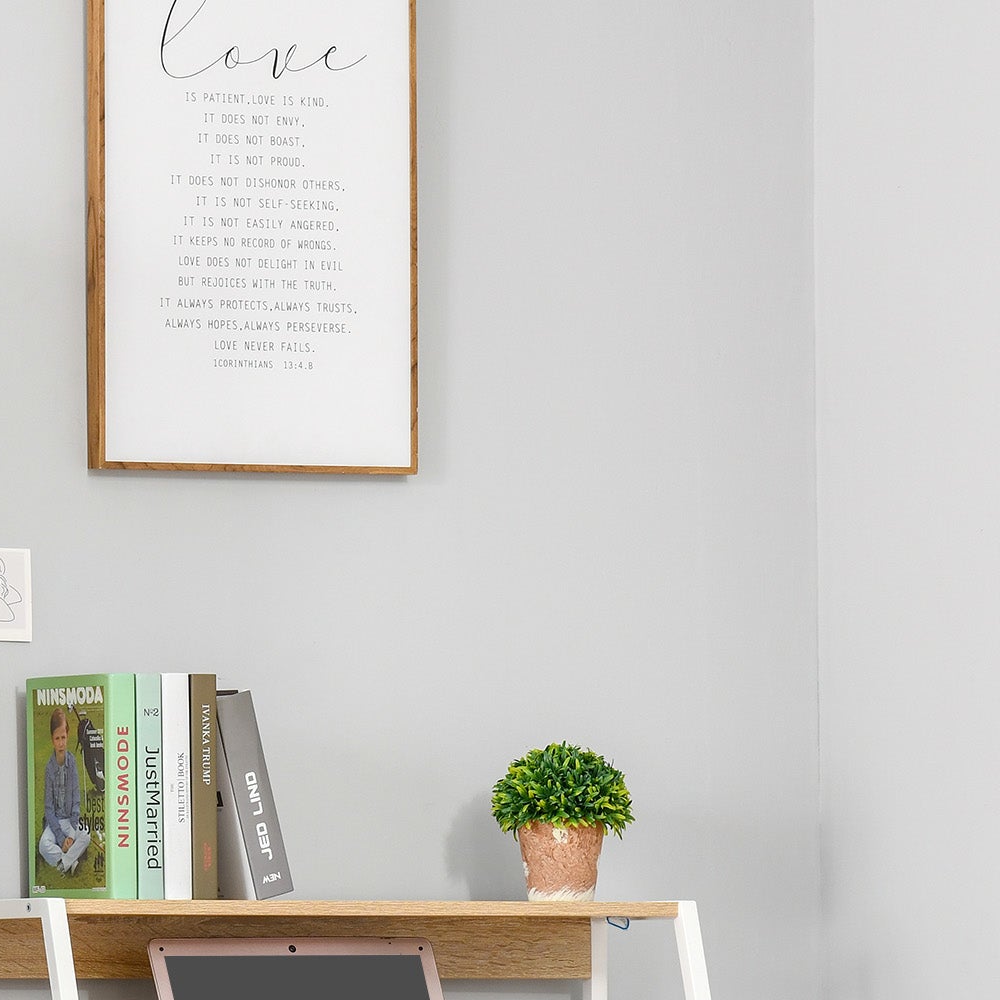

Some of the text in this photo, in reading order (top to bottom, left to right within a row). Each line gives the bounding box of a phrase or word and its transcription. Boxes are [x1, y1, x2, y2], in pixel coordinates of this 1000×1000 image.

[185, 92, 197, 103] IS
[282, 95, 295, 107] IS
[203, 112, 215, 124] IT
[221, 113, 246, 125] DOES
[251, 114, 270, 126] NOT
[197, 133, 209, 144] IT
[215, 133, 240, 145] DOES
[245, 134, 264, 146] NOT
[210, 153, 221, 165] IT
[228, 154, 240, 166] IS
[245, 154, 264, 167] NOT
[170, 174, 182, 186] IT
[188, 175, 214, 187] DOES
[220, 176, 239, 188] NOT
[245, 177, 297, 190] DISHONOR
[195, 195, 208, 207] IT
[215, 196, 227, 208] IS
[233, 197, 252, 209] NOT
[183, 216, 195, 227] IT
[202, 216, 215, 228] IS
[220, 217, 239, 228] NOT
[245, 218, 283, 231] EASILY
[172, 235, 184, 246] IT
[189, 236, 218, 248] KEEPS
[223, 237, 236, 248] NO
[240, 237, 275, 249] RECORD
[280, 238, 292, 249] OF
[178, 255, 344, 272] LOVE DOES NOT DELIGHT IN EVIL
[177, 276, 197, 287] BUT
[201, 277, 247, 289] REJOICES
[251, 278, 276, 290] WITH
[281, 278, 298, 290] THE
[159, 297, 171, 308] IT
[176, 298, 214, 310] ALWAYS
[164, 318, 202, 330] ALWAYS
[213, 339, 238, 351] LOVE
[243, 341, 275, 353] NEVER
[36, 686, 103, 706] NINSMODA
[201, 703, 211, 786] IVANKA TRUMP
[117, 726, 130, 848] NINSMODE
[176, 752, 186, 823] STILETTO BOOK
[87, 796, 105, 813] best
[78, 812, 105, 834] styles
[244, 771, 273, 860] JED LIND
[262, 871, 282, 884] NEW
